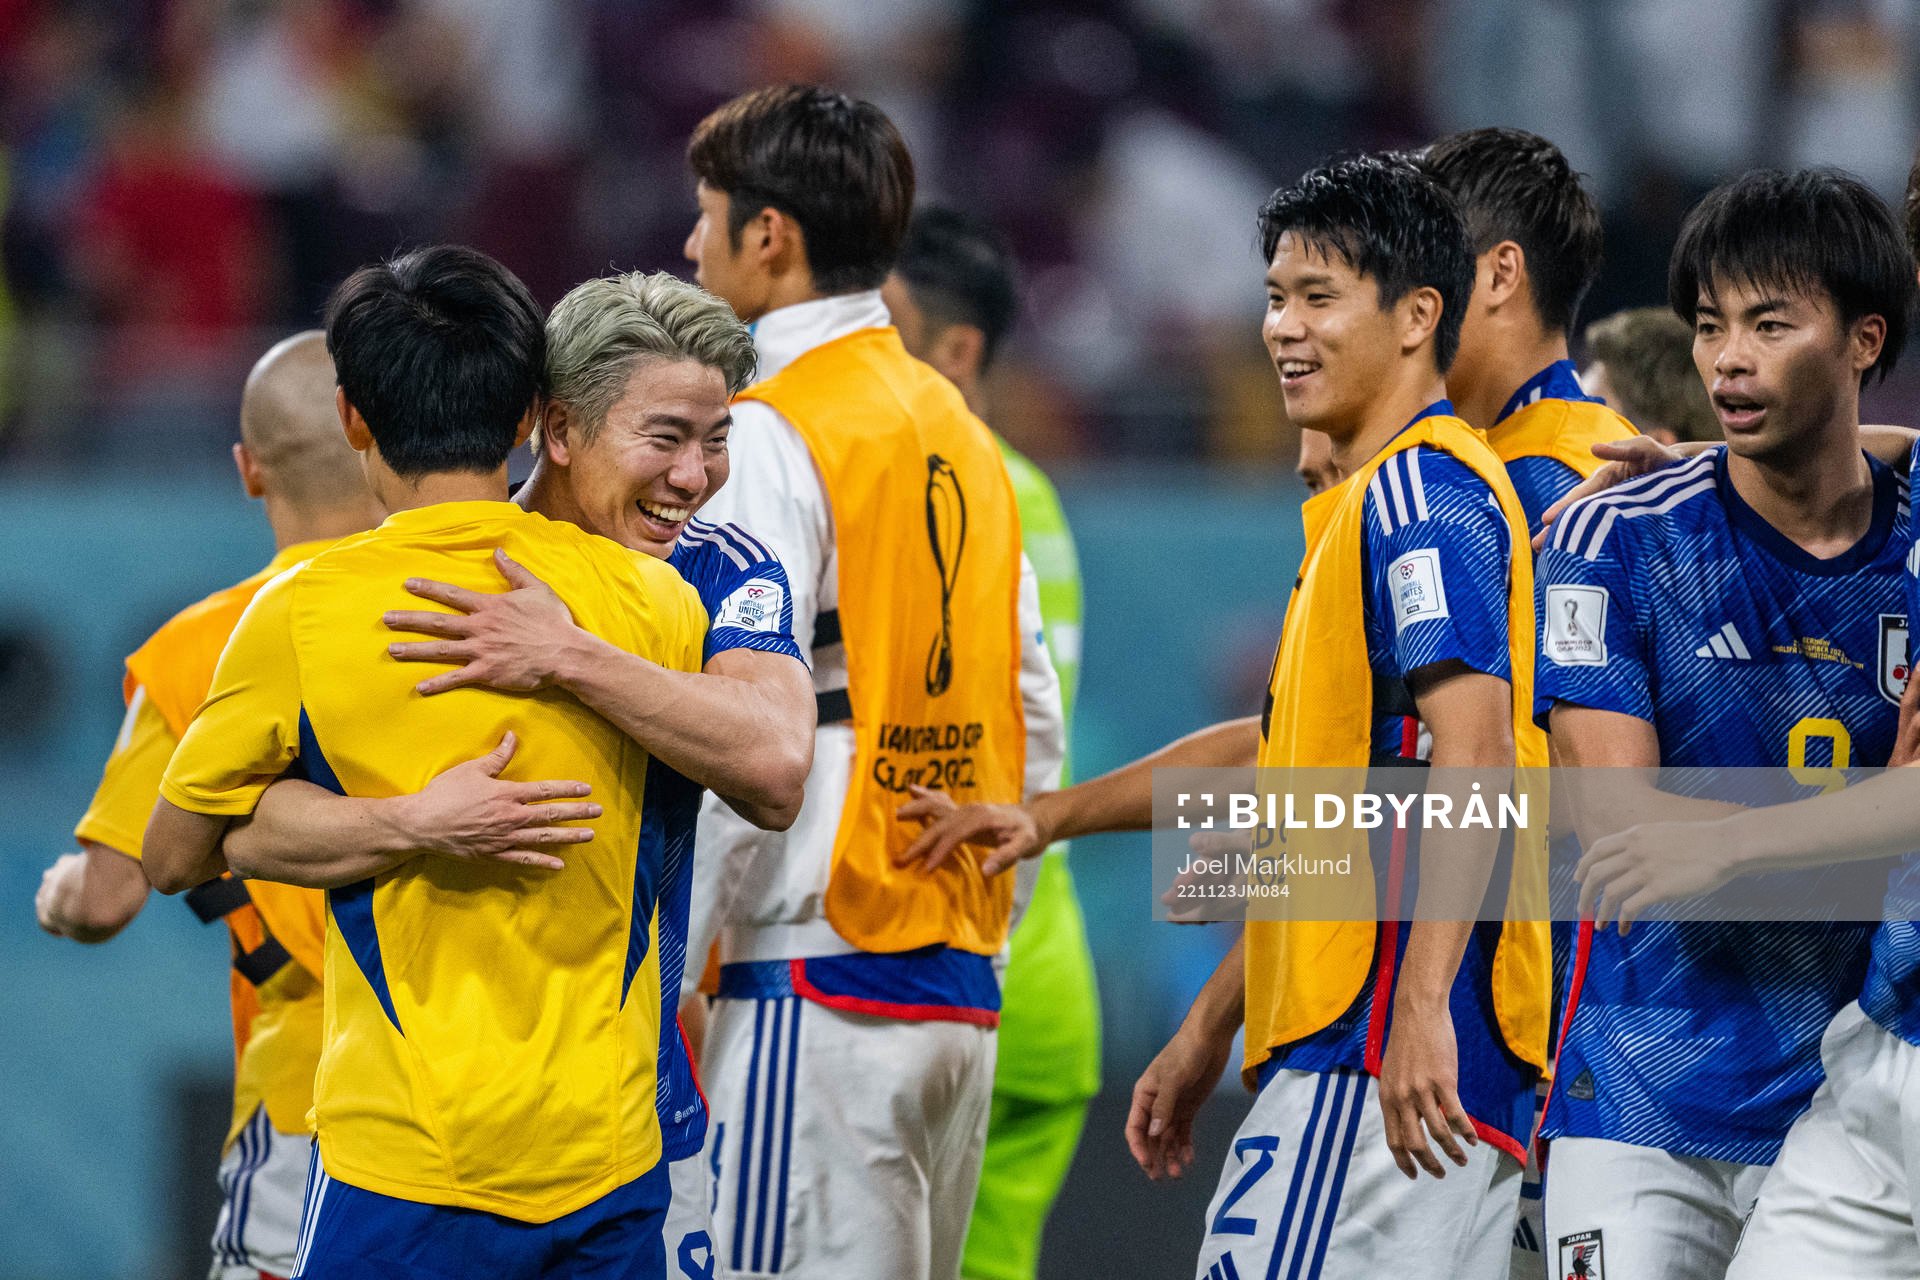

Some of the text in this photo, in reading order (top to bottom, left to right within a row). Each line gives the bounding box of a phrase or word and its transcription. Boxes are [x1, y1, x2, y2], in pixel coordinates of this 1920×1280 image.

[1788, 717, 1851, 796] 9
[1211, 1136, 1280, 1236] 2
[1567, 1232, 1592, 1244] JAPAN
